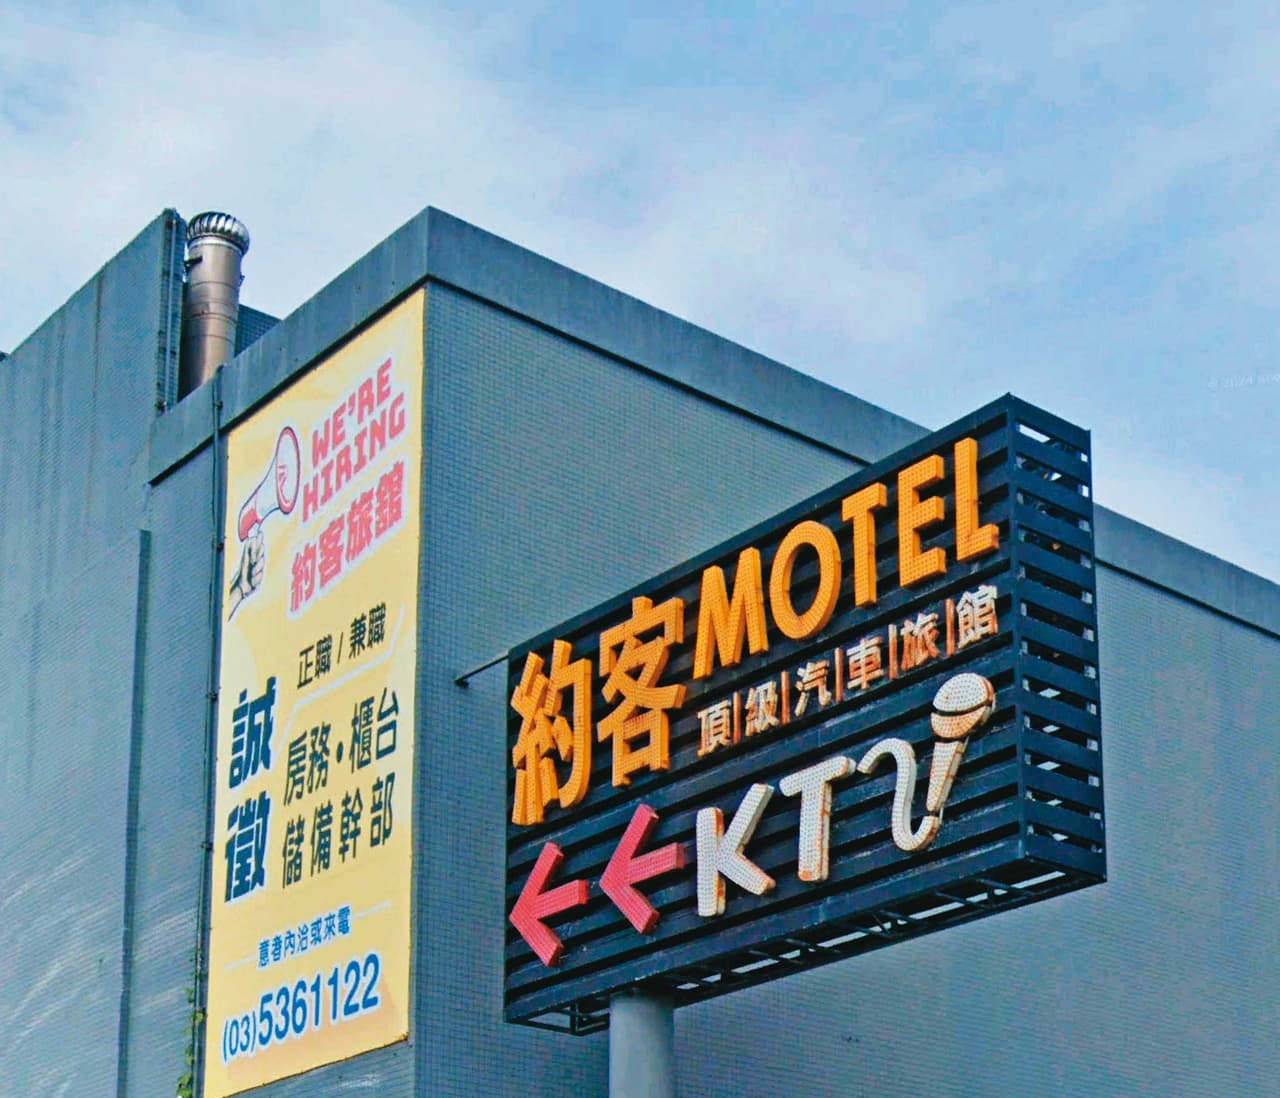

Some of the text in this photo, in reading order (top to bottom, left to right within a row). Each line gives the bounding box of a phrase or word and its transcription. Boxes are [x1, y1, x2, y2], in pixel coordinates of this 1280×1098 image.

[302, 392, 405, 523] HIRING
[312, 357, 392, 468] WE'RE
[290, 460, 404, 613] 約客旅館
[510, 436, 1001, 826] 約客 MOTEL
[224, 676, 277, 903] 誠徵
[283, 772, 396, 890] 儲備幹部
[223, 953, 381, 1065] (03)5361122
